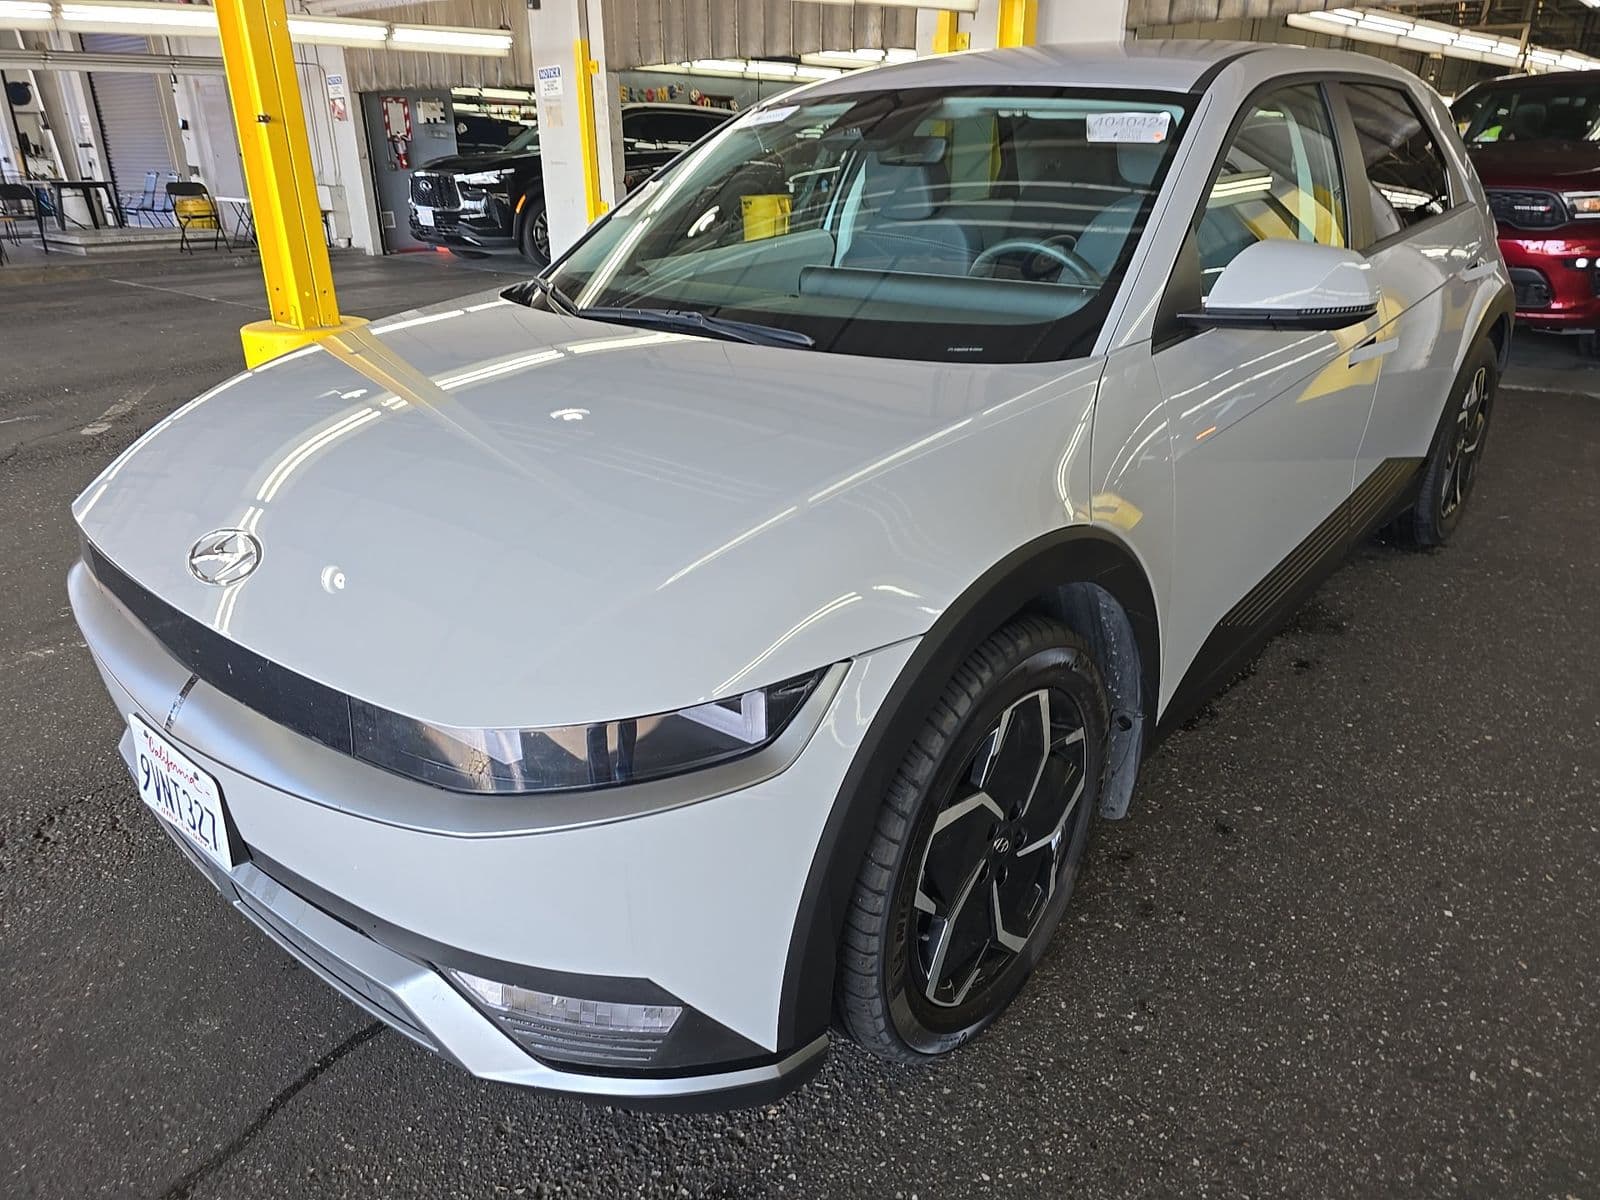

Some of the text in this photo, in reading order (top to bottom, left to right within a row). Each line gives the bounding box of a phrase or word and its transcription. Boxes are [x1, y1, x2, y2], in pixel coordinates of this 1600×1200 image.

[539, 67, 560, 79] NOTICE
[620, 85, 677, 102] ELCOME
[148, 736, 202, 793] California
[141, 754, 217, 851] 9VNT327
